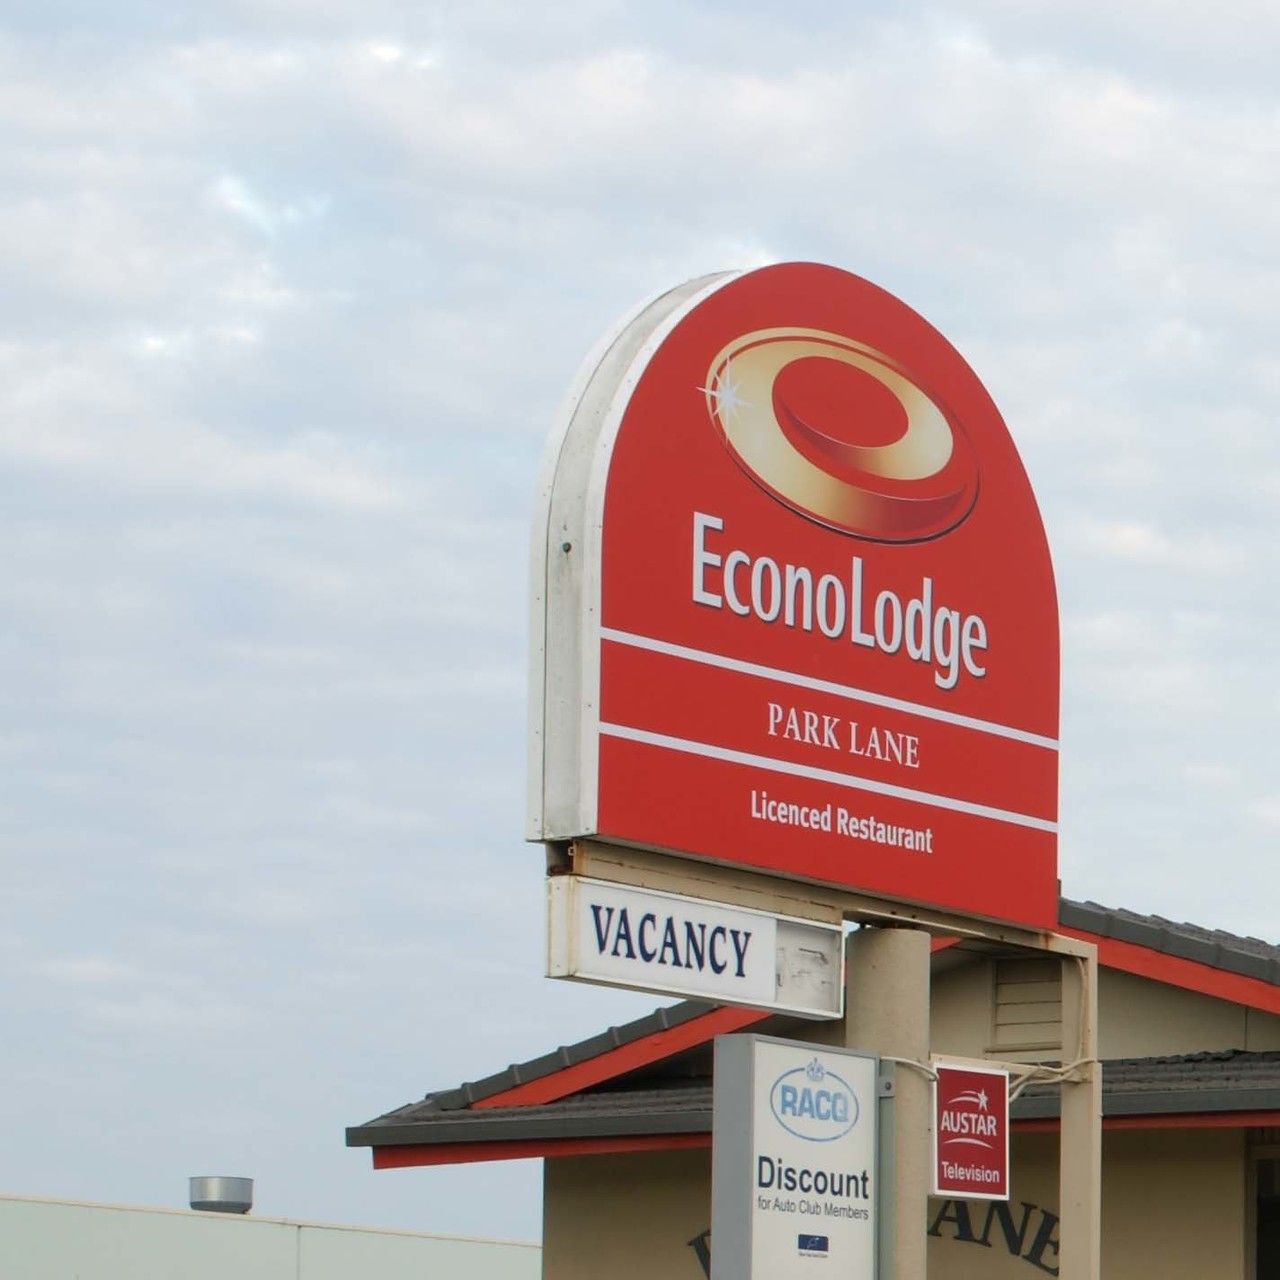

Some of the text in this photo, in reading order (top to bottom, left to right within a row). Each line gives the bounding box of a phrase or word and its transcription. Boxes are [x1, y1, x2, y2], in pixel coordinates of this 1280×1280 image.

[692, 511, 988, 690] EconoLodge
[767, 702, 920, 769] PARK LANE
[751, 790, 933, 854] Licenced Restaurant
[591, 904, 752, 978] VACANCY
[780, 1084, 849, 1122] RACQ
[940, 1110, 997, 1137] AUSTAR
[758, 1155, 869, 1199] Discount
[941, 1161, 1000, 1183] Television
[758, 1195, 869, 1220] for Auto Club Members
[927, 1200, 1059, 1277] ANE
